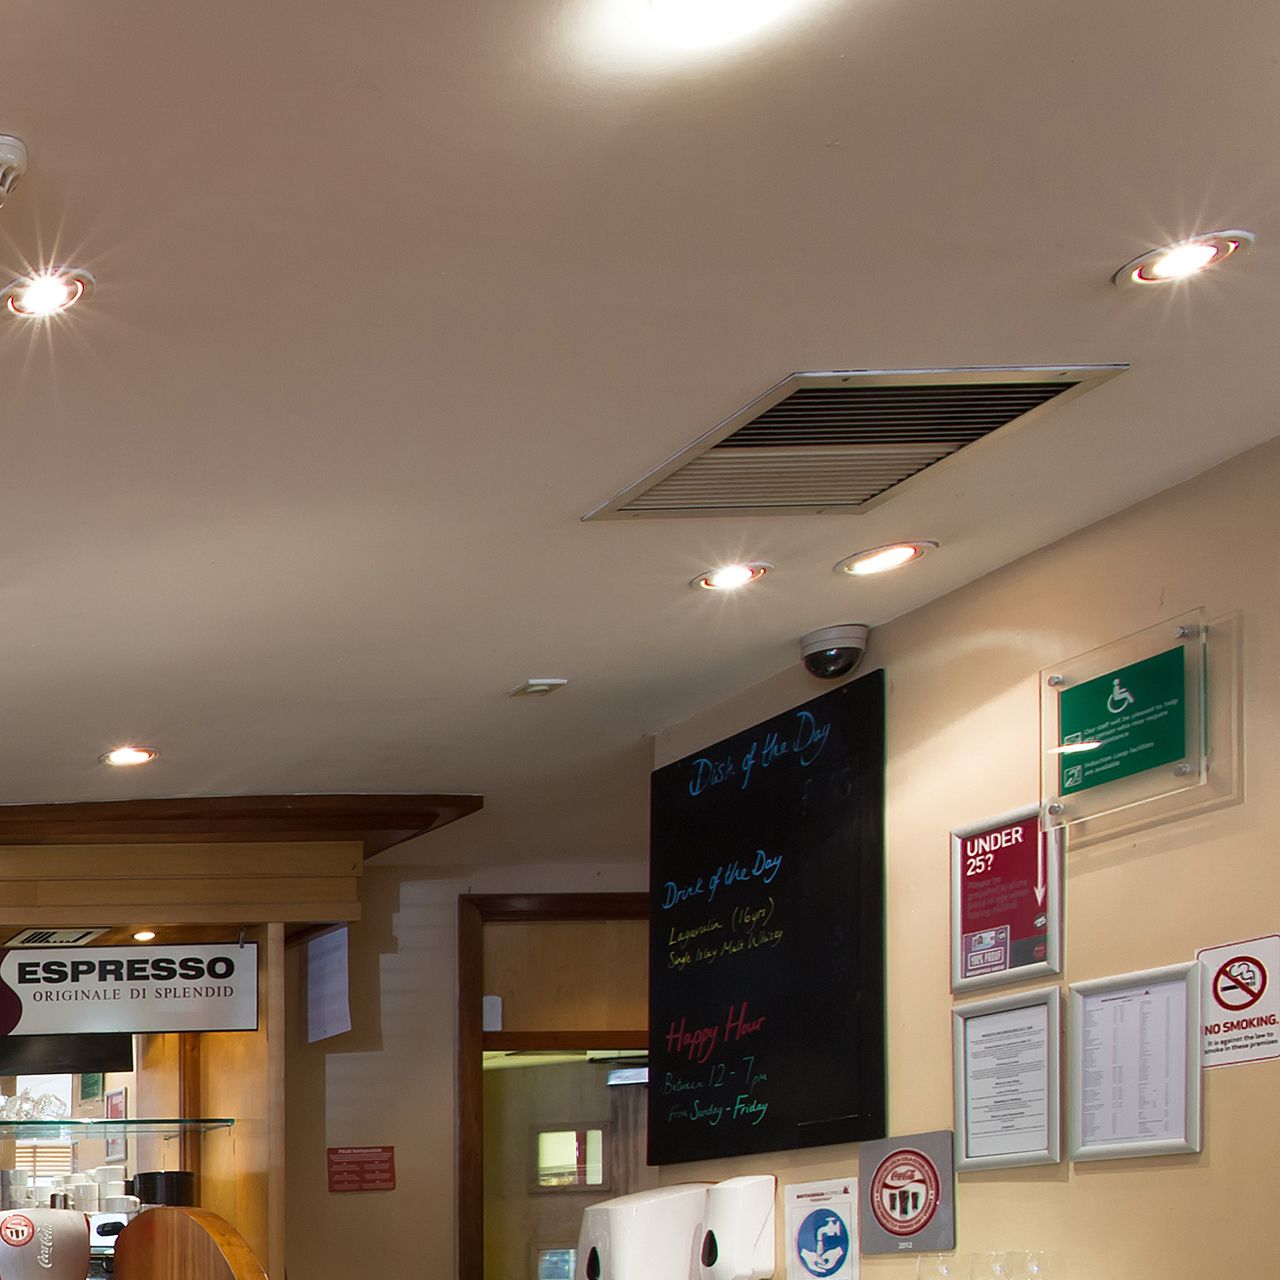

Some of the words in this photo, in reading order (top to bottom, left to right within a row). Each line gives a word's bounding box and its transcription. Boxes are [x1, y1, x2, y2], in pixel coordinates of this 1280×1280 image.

[741, 741, 758, 790] of
[761, 732, 788, 768] the
[792, 711, 831, 767] Day
[966, 826, 1024, 857] UNDER
[708, 866, 722, 902] of
[724, 861, 750, 886] the
[752, 849, 782, 884] Day
[966, 853, 994, 876] 25?
[17, 956, 235, 985] ESPRESSO
[32, 988, 121, 1003] ORIGINALE
[130, 988, 146, 1000] DI
[154, 985, 235, 1000] SPLENDID
[666, 1016, 719, 1064] Happy
[724, 1001, 766, 1042] Hour
[1204, 1024, 1220, 1036] NO
[1223, 1014, 1279, 1033] SMOKING.
[1220, 1036, 1242, 1046] against
[708, 1063, 725, 1088] 12
[732, 1094, 768, 1126] Friday
